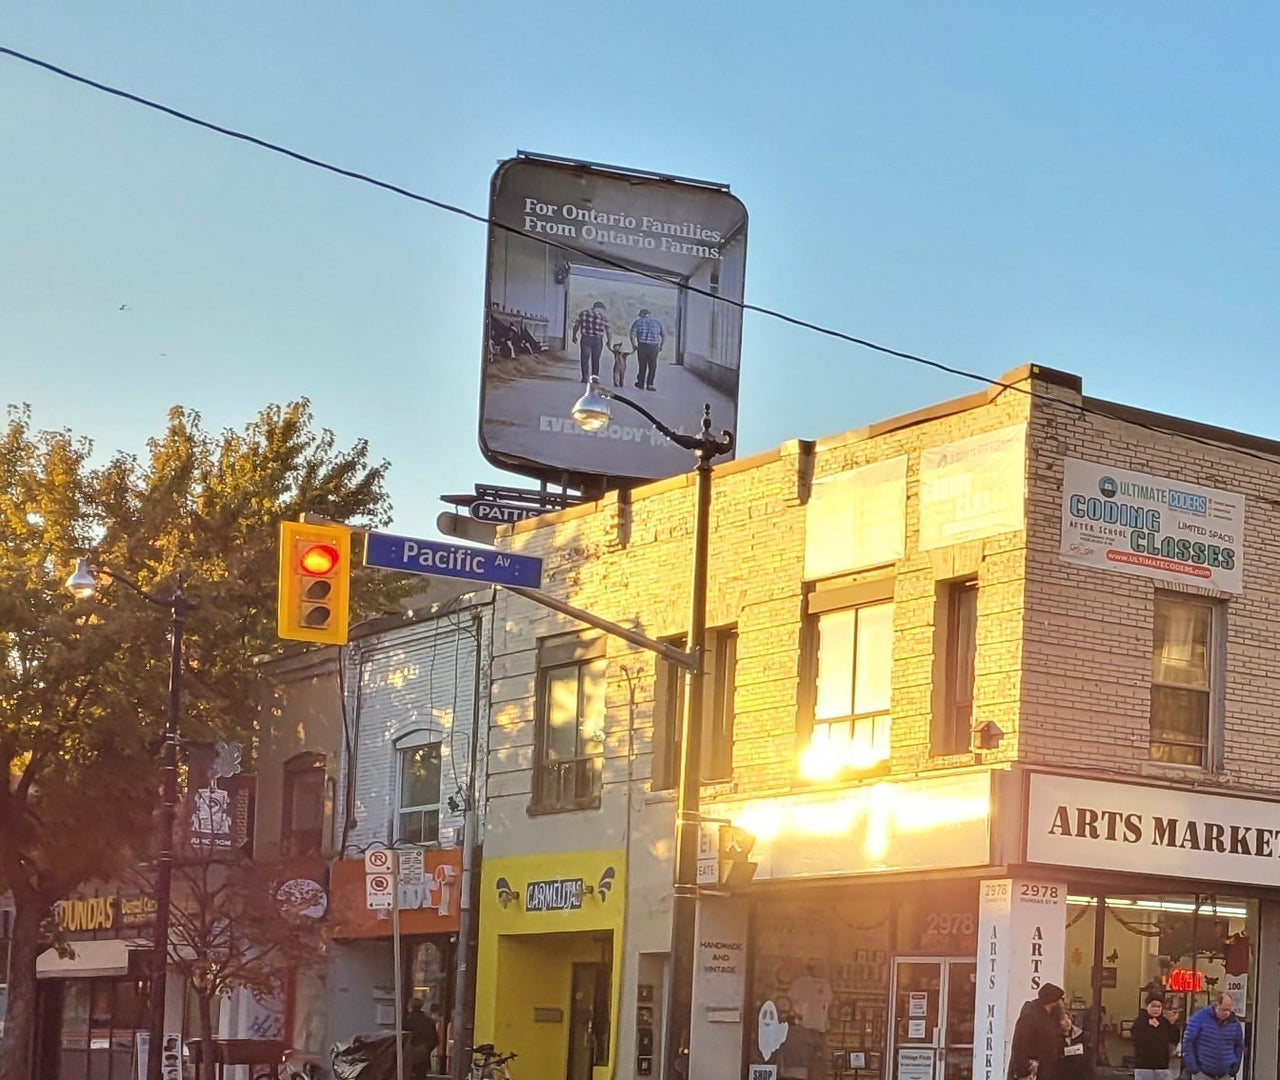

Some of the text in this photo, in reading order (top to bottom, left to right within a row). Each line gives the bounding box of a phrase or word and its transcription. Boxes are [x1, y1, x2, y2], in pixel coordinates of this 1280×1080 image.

[524, 198, 726, 243] For Ontario Families.
[524, 216, 724, 260] From Ontario Farms.
[539, 416, 644, 442] EVERBODY
[1119, 481, 1167, 504] ULTIMATE
[1170, 491, 1206, 513] CODERS
[1069, 494, 1161, 533] CODING
[1178, 521, 1207, 536] LIMITED
[1069, 521, 1094, 532] AFTER
[1099, 525, 1127, 539] SCHOOL
[403, 541, 511, 573] Pacific Av
[1107, 552, 1211, 577] www.ULTIMATECODERS.com
[1130, 530, 1236, 571] CLASSES
[1048, 805, 1143, 844] ARTS
[985, 883, 1008, 897] 2978
[1021, 884, 1058, 899] 2978
[927, 913, 974, 935] 2978
[988, 924, 998, 990] ARTS
[1031, 926, 1044, 991] ARTS
[753, 1069, 773, 1080] SHOP
